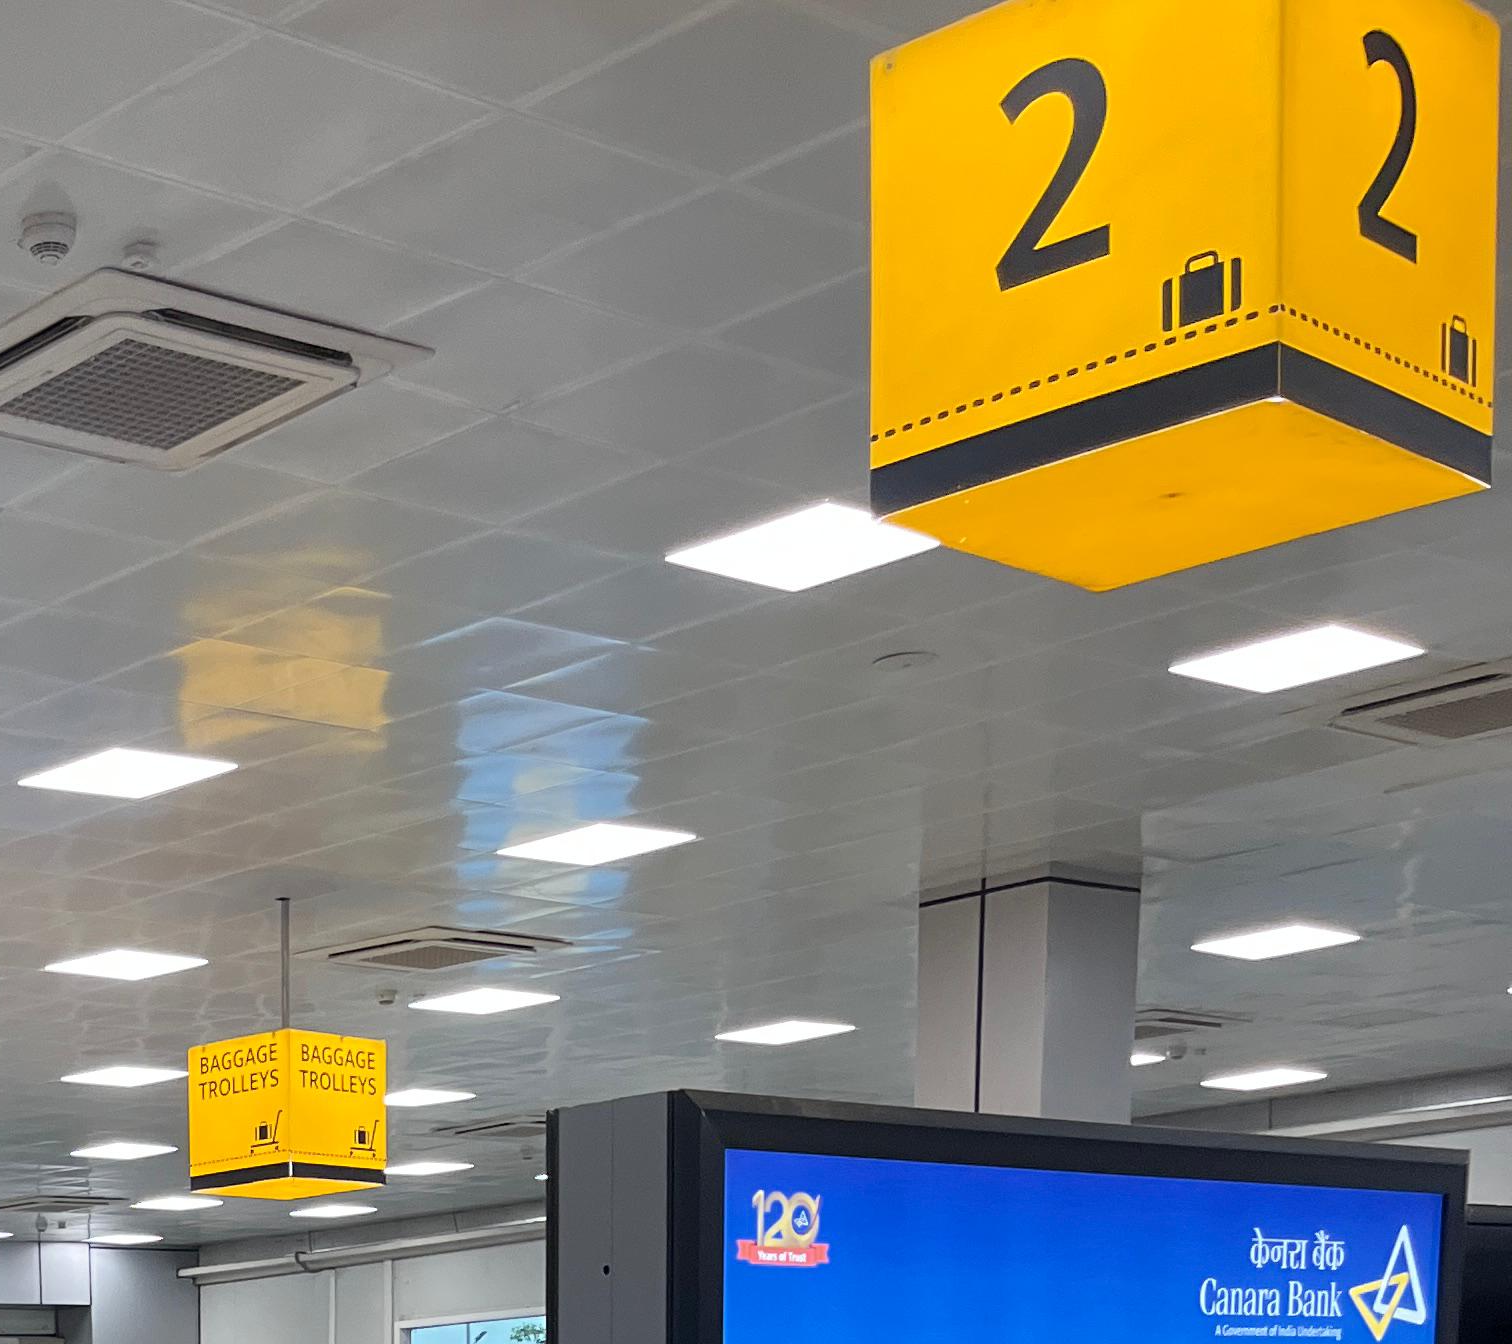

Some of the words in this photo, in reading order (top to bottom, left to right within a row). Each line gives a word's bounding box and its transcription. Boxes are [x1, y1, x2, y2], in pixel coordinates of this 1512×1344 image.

[1358, 29, 1418, 265] 2
[996, 57, 1111, 292] 2
[200, 1043, 278, 1075] BAGGAGE
[301, 1044, 376, 1070] BAGGAGE
[199, 1069, 279, 1100] TROLLEYS
[299, 1069, 377, 1096] TROLLEYS
[752, 1189, 820, 1248] 120
[1250, 1227, 1309, 1270] केनरा
[1311, 1229, 1345, 1271] बैंक
[1199, 1277, 1280, 1317] Canara
[1287, 1280, 1343, 1317] Bank
[1215, 1325, 1222, 1336] A
[1222, 1325, 1267, 1337] Government
[1269, 1325, 1278, 1337] of
[1278, 1325, 1297, 1337] India
[1297, 1326, 1342, 1341] Undertaking
